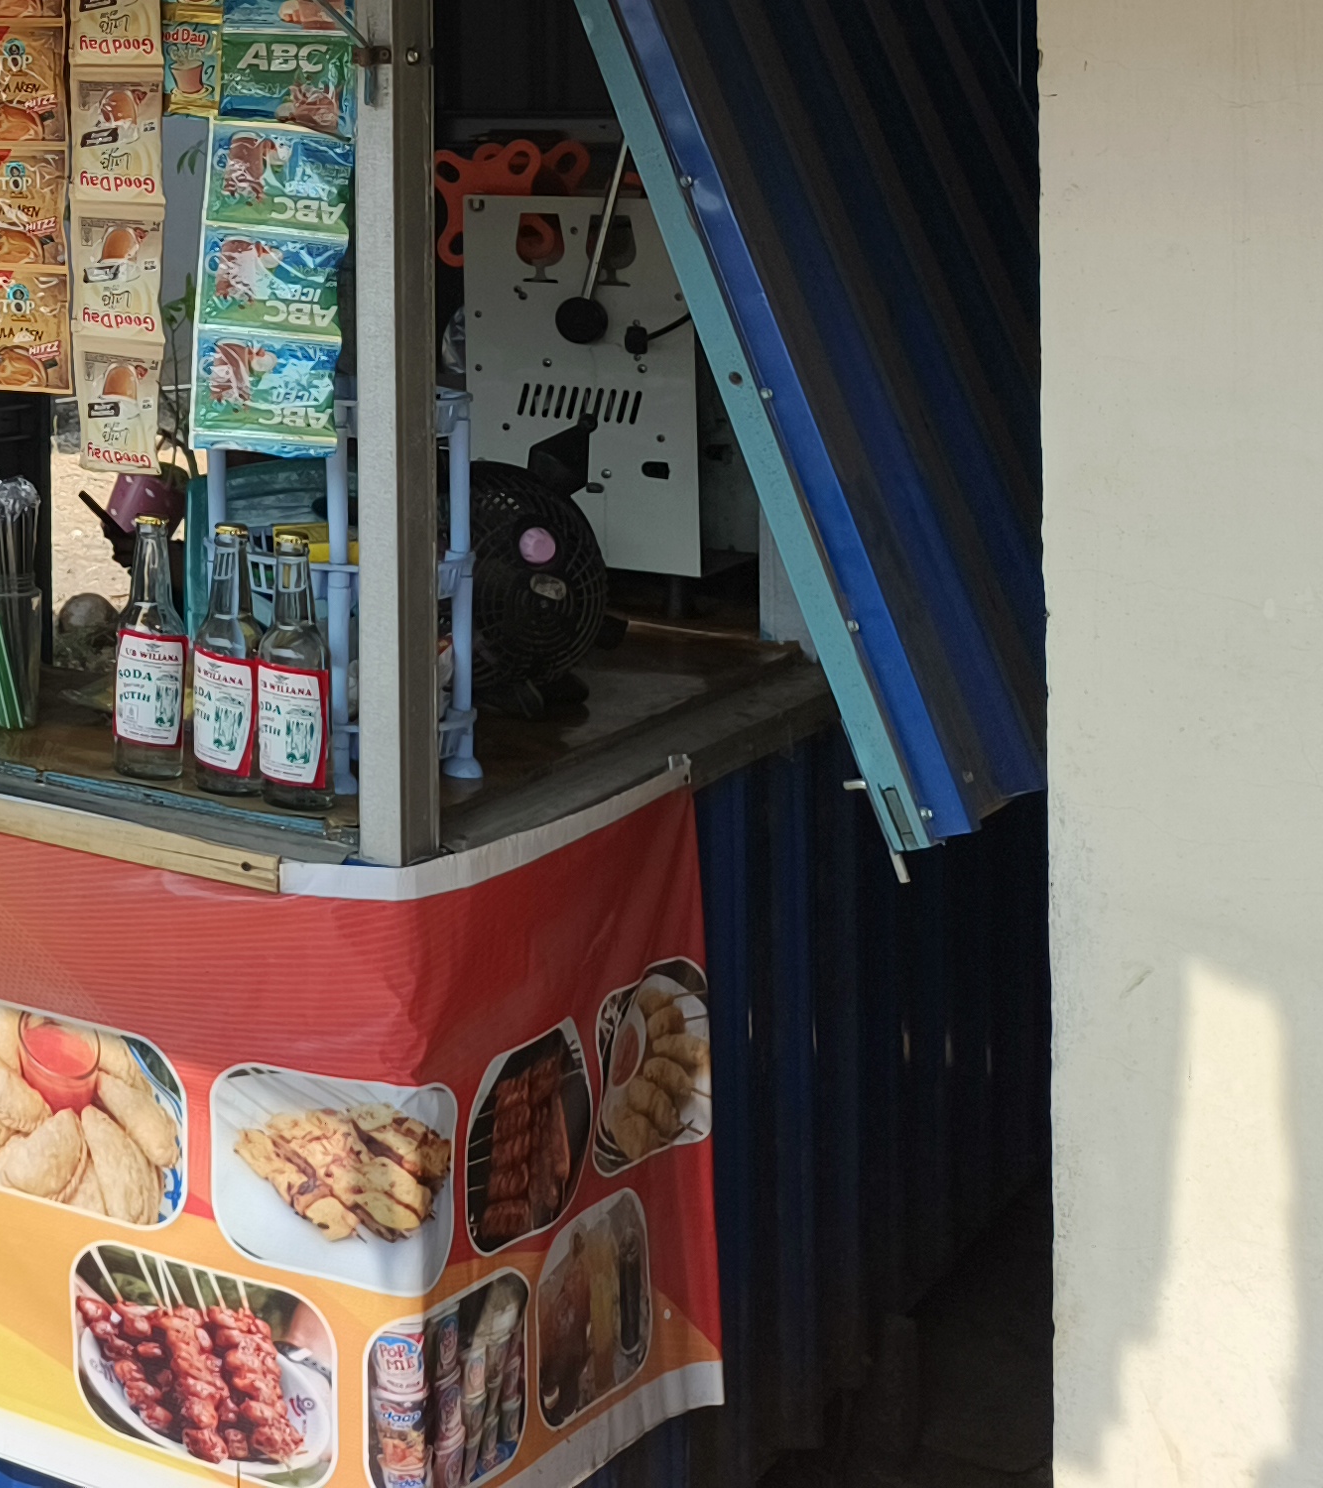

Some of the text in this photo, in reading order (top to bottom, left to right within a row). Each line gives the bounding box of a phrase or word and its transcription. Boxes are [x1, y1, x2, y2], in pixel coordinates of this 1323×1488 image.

[79, 34, 155, 55] Good Day
[236, 42, 329, 73] ABC
[79, 170, 156, 194] Good Day
[270, 196, 347, 225] ABC
[82, 309, 156, 333] Good Day
[263, 300, 339, 327] ABC
[257, 406, 333, 430] ABC
[118, 668, 153, 682] SODA
